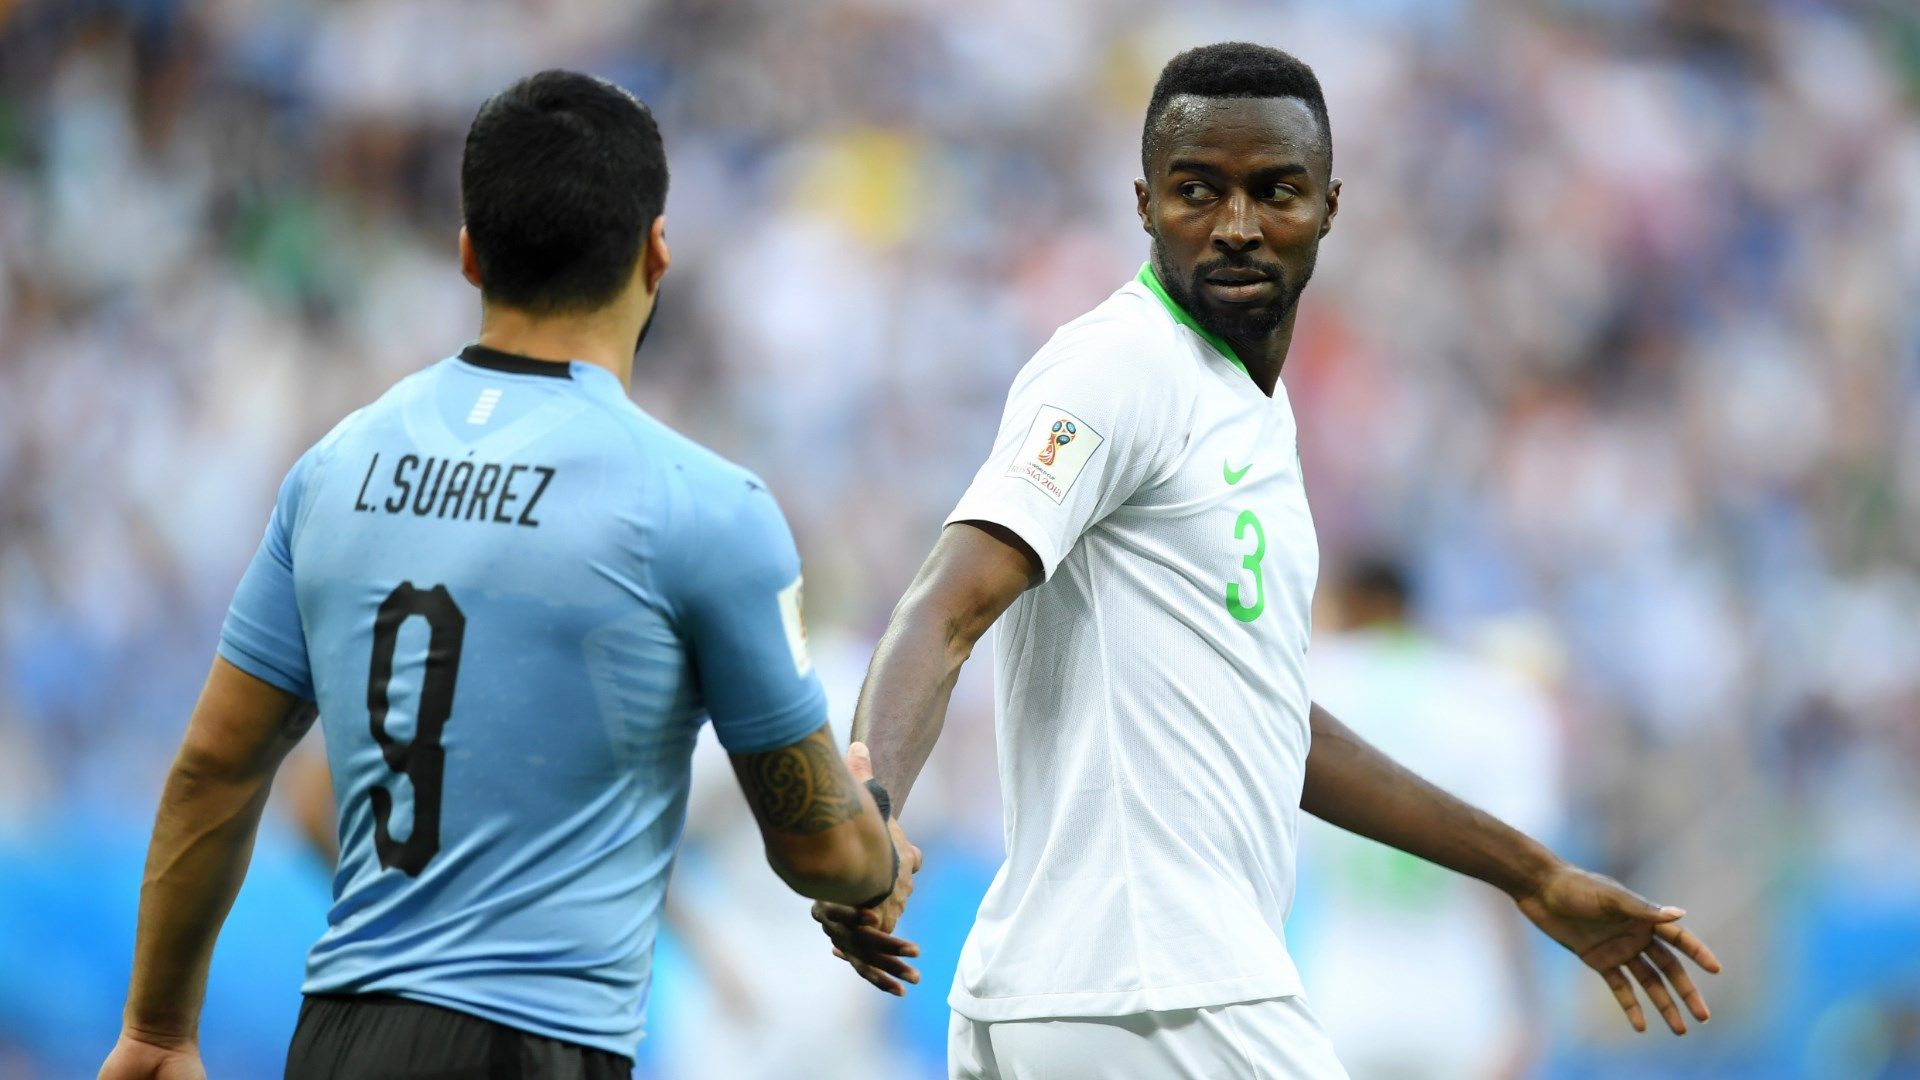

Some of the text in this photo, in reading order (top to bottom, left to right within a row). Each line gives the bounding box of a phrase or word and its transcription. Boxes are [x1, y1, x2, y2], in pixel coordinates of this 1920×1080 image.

[1041, 478, 1062, 497] 2018
[1226, 509, 1265, 622] 3
[367, 580, 466, 879] 9
